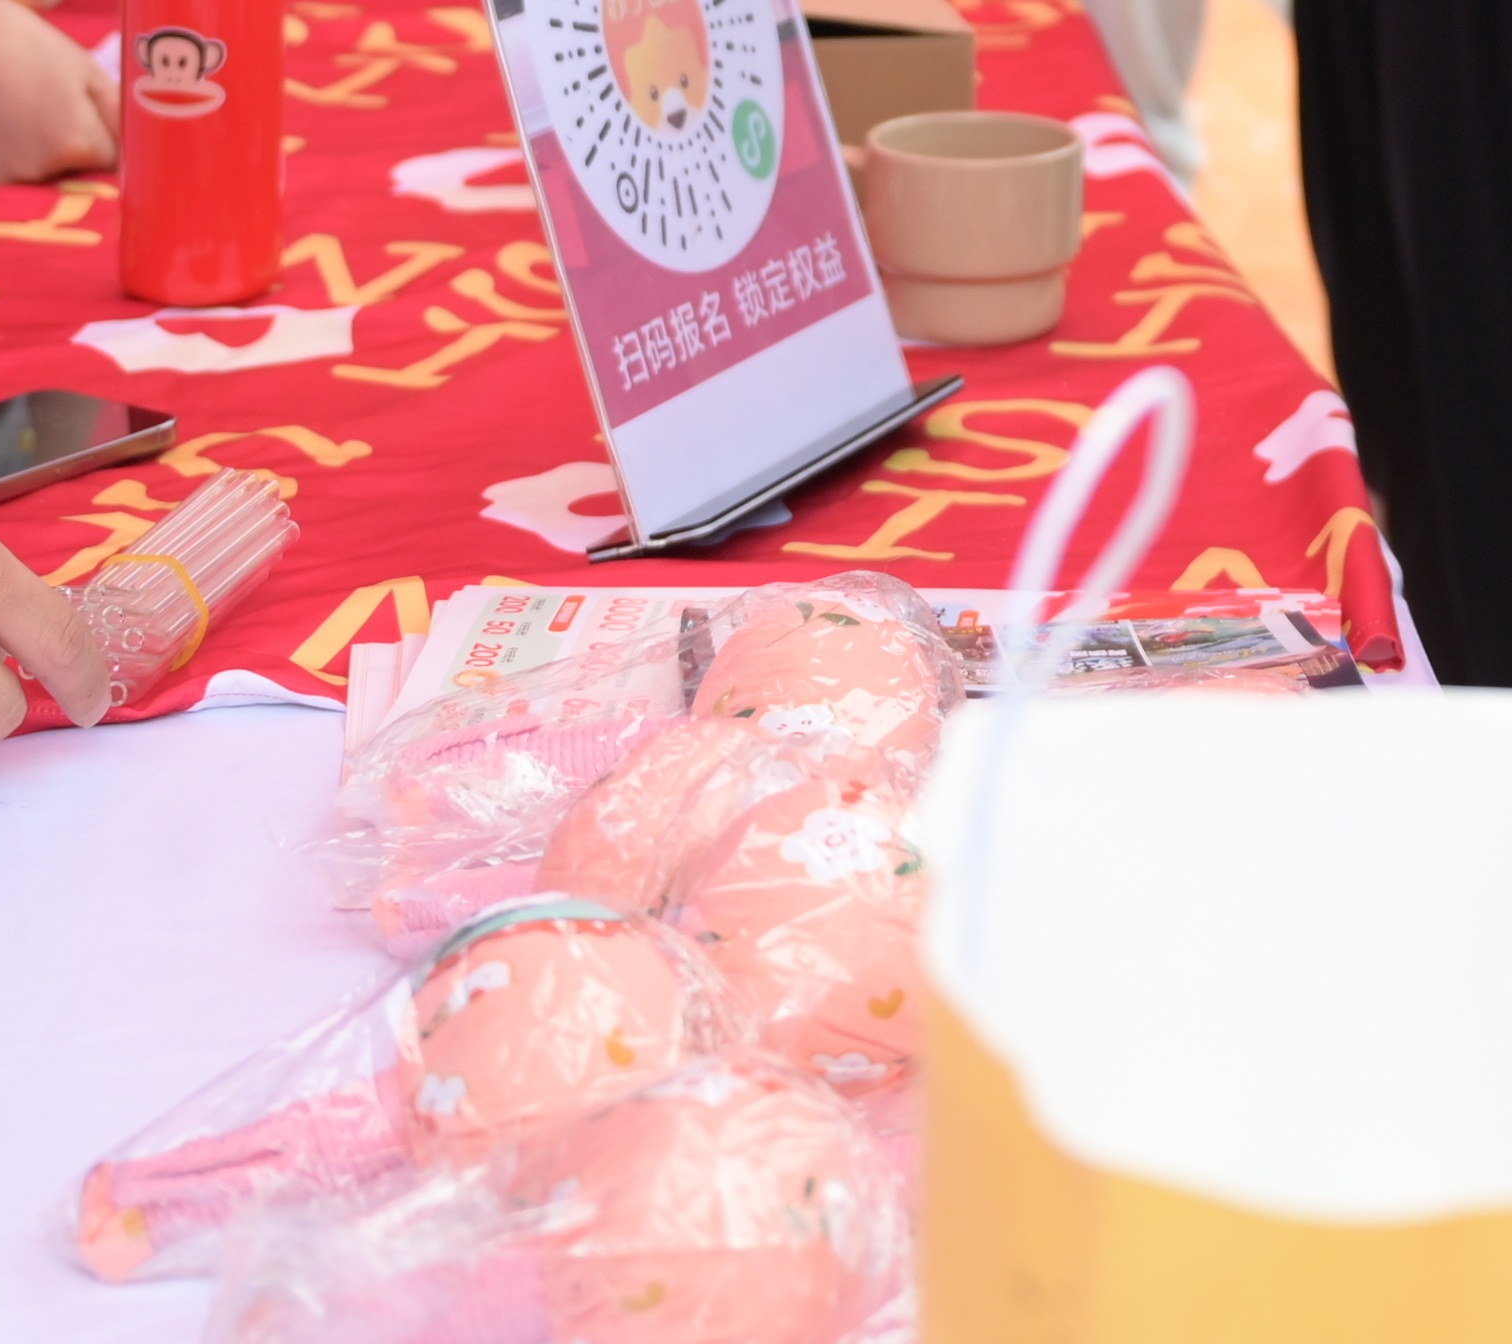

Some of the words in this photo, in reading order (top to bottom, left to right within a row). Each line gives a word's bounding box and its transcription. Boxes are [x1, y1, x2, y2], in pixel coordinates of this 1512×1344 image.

[612, 291, 732, 391] 扫码报名
[733, 231, 847, 328] 锁定权益
[495, 595, 532, 614] 200
[482, 620, 516, 635] 50
[465, 642, 503, 667] 200
